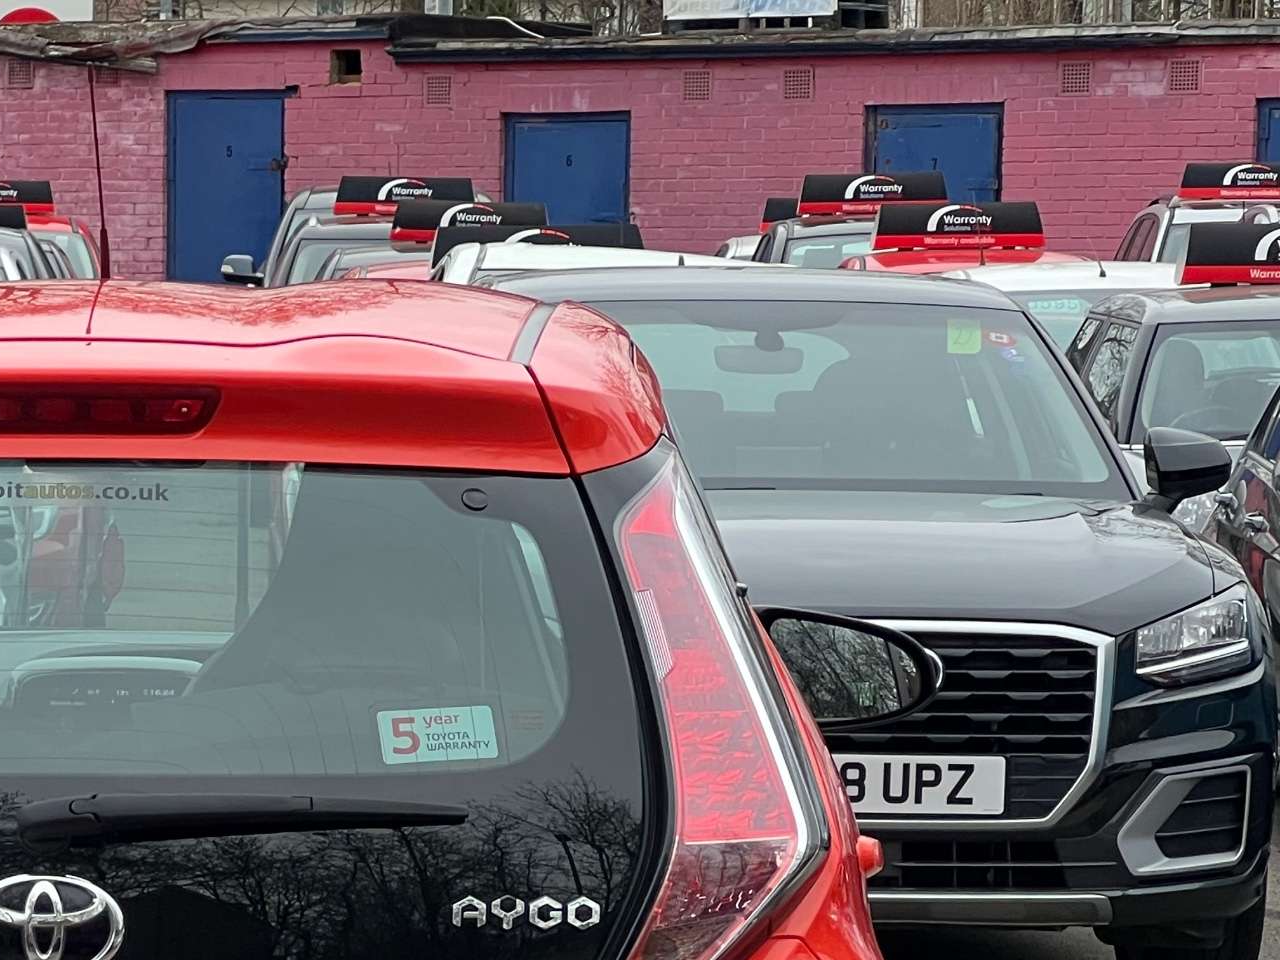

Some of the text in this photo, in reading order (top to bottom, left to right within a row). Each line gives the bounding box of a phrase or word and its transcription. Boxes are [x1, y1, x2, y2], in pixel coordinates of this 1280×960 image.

[566, 154, 573, 167] 6
[1237, 172, 1279, 181] Warranty
[392, 186, 433, 197] Warranty
[860, 183, 903, 195] Warranty
[456, 212, 502, 224] Warranty
[943, 214, 993, 226] Warranty
[391, 713, 460, 755] 5 year
[425, 731, 470, 743] TOYOTA
[426, 740, 490, 752] WARRANTY
[883, 762, 975, 805] UPZ
[452, 894, 601, 931] AYGO
